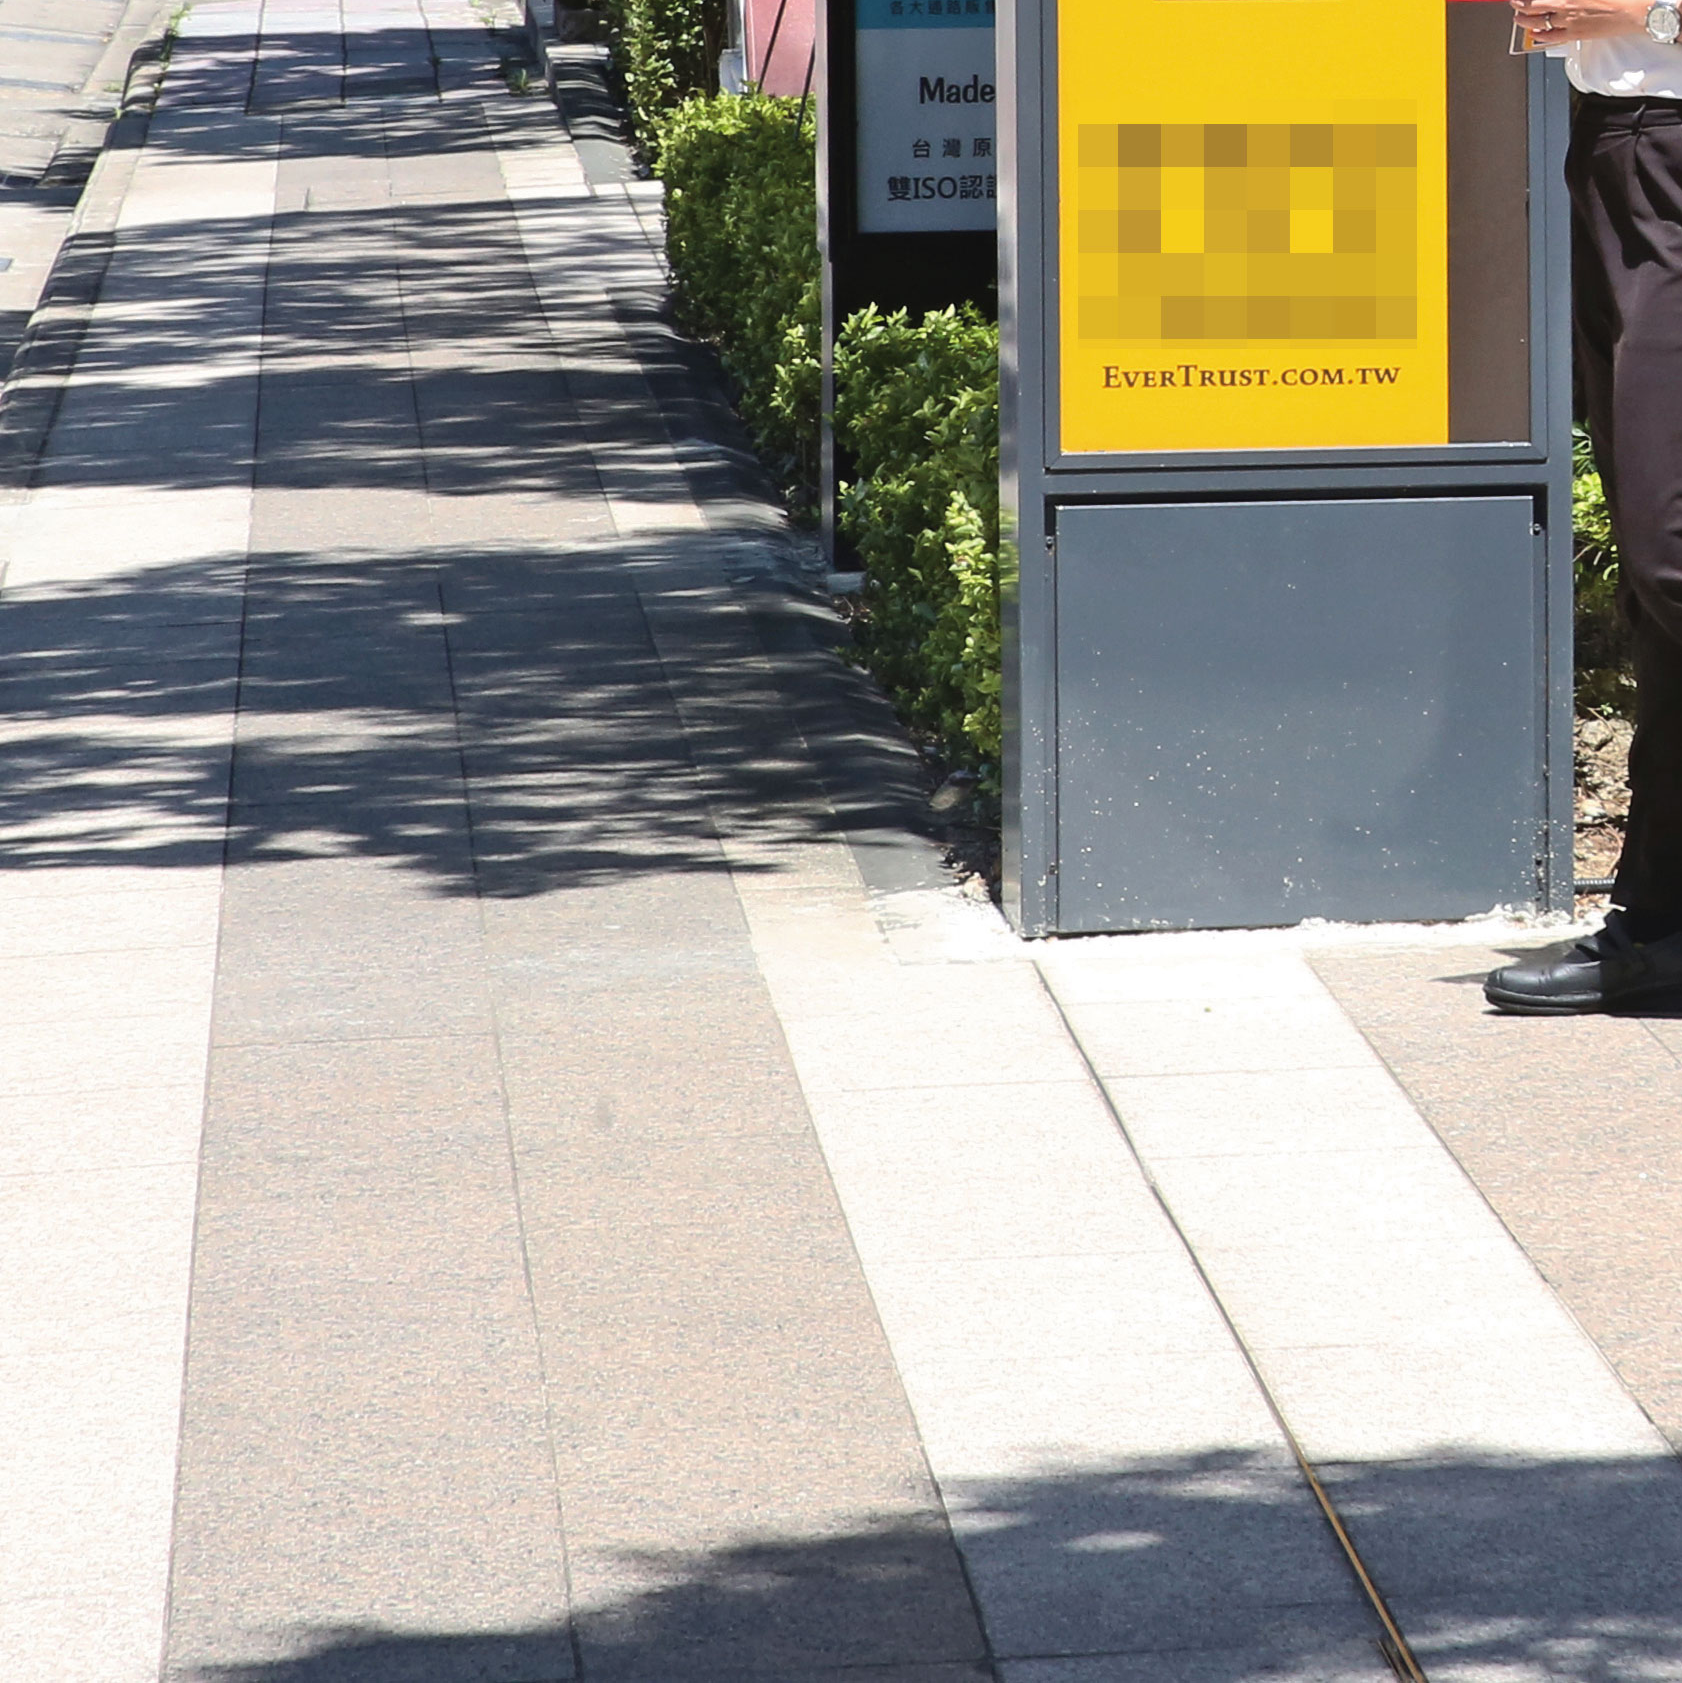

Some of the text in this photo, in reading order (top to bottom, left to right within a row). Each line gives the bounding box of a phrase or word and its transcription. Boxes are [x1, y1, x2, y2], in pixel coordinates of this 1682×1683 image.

[919, 74, 996, 104] Made
[912, 137, 992, 158] 台灣原
